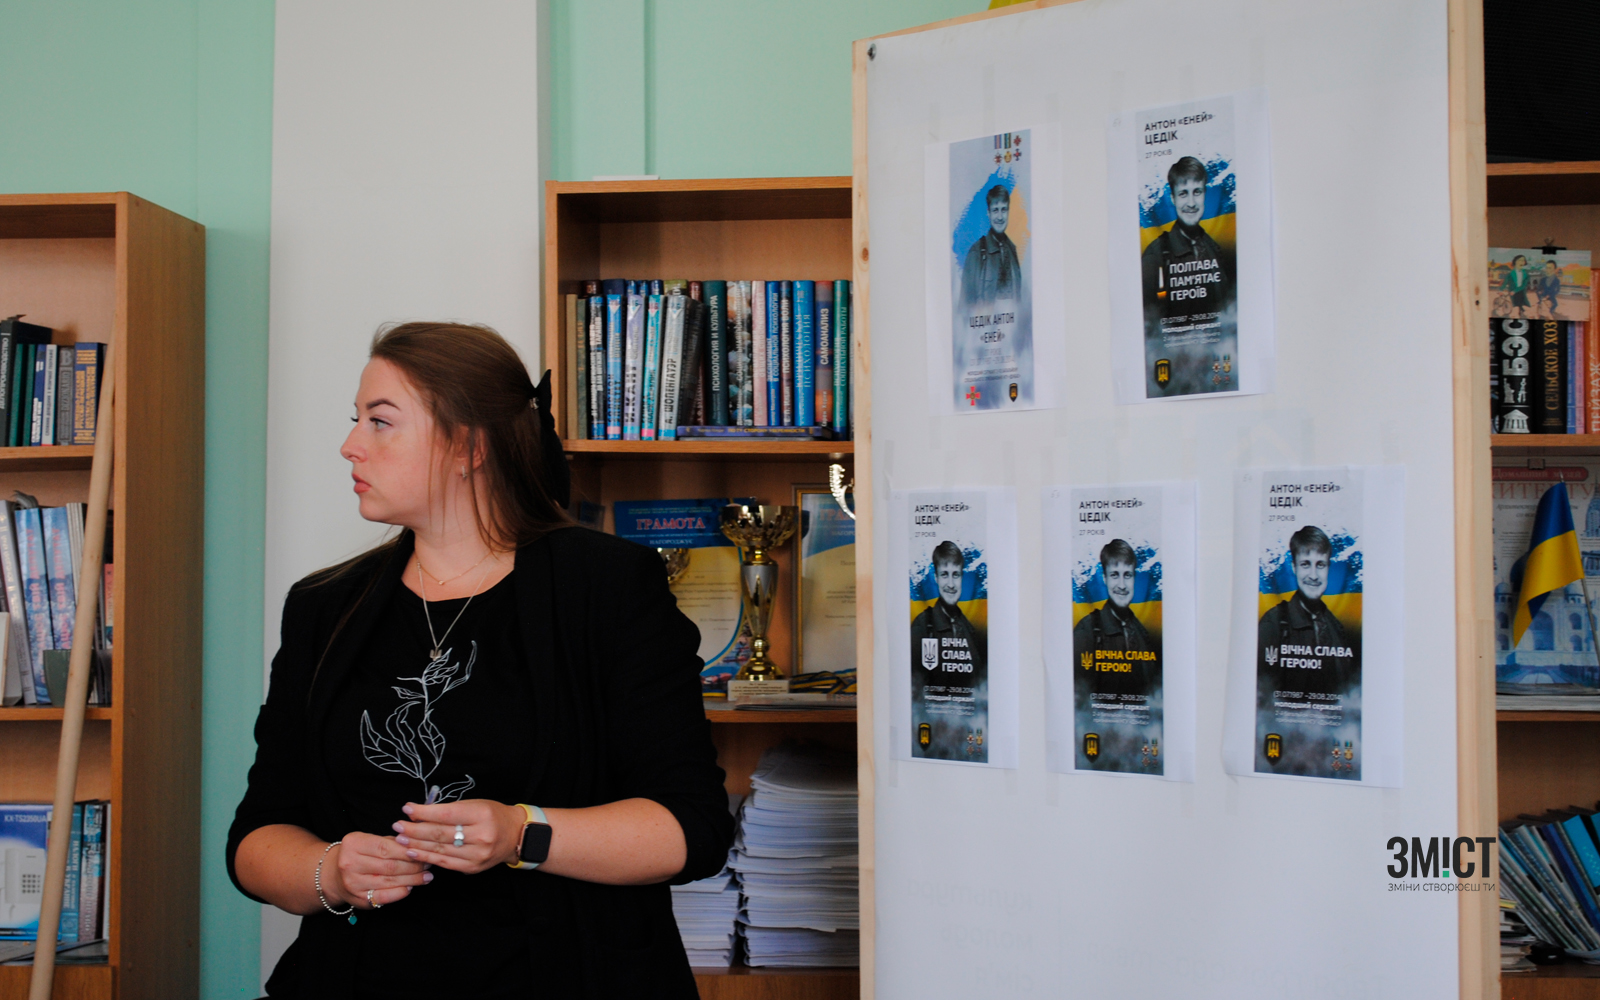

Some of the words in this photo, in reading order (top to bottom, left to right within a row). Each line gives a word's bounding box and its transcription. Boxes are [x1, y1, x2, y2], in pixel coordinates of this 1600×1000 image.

[1144, 117, 1176, 133] АНТОН
[1177, 112, 1214, 127] «ЕНЕЙ»
[1145, 130, 1178, 145] ЦЕДІК
[1145, 151, 1152, 159] 27
[1153, 149, 1173, 158] РОКІВ
[1169, 259, 1219, 275] ПОЛТАВА
[1170, 287, 1208, 302] ГЕРОЇВ
[709, 294, 719, 331] КУЛЬТУРА
[771, 292, 779, 334] ПСИХОЛОГИИ
[969, 317, 992, 329] ЦЕДІК
[993, 312, 1015, 325] АНТОН
[1161, 323, 1195, 334] молодший
[1195, 321, 1222, 332] сержант
[820, 307, 830, 365] САМОАНАЛИЗ
[979, 330, 1006, 344] «ЕНЕЙ»
[1543, 320, 1559, 346] ХОЗ
[781, 322, 790, 374] ПСИХОЛОГИЯ
[803, 314, 811, 388] ПСИХОЛОГИЯ
[1502, 319, 1530, 376] БЭС
[710, 340, 721, 391] ПСИХОЛОГИЯ
[663, 358, 678, 413] ШОПЕНГАУЭР
[1543, 348, 1559, 411] СЕЛЬСКОЕ
[60, 371, 71, 411] DIZIONARIO
[665, 415, 674, 425] А.
[1270, 484, 1302, 494] АНТОН
[1303, 481, 1341, 493] «ЕНЕЙ»
[914, 504, 940, 514] АНТОН
[940, 502, 969, 512] «ЕНЕЙ»
[1079, 500, 1109, 509] АНТОН
[1111, 498, 1143, 509] «ЕНЕЙ»
[1269, 496, 1303, 509] ЦЕДІК
[820, 508, 855, 521] ГРА
[914, 515, 941, 525] ЦЕДІК
[1079, 512, 1111, 523] ЦЕДІК
[636, 517, 706, 531] ГРАМОТА
[25, 527, 39, 580] ДЕПУТАТ
[51, 527, 66, 580] ДЕПУТАТ
[29, 582, 41, 609] ТВІЙ
[54, 582, 66, 609] ТВІЙ
[60, 614, 71, 650] АЦЮЄ
[941, 637, 969, 648] ВІЧНА
[941, 650, 972, 661] СЛАВА
[1095, 650, 1124, 661] ВІЧНА
[1125, 650, 1157, 661] СЛАВА
[1280, 644, 1313, 656] ВІЧНА
[1314, 646, 1353, 658] СЛАВА
[941, 662, 974, 673] ГЕРОЮ
[1095, 662, 1132, 673] ГЕРОЮ!
[1280, 657, 1322, 669] ГЕРОЮ!
[1274, 700, 1312, 711] молодший
[1312, 702, 1343, 712] сержант
